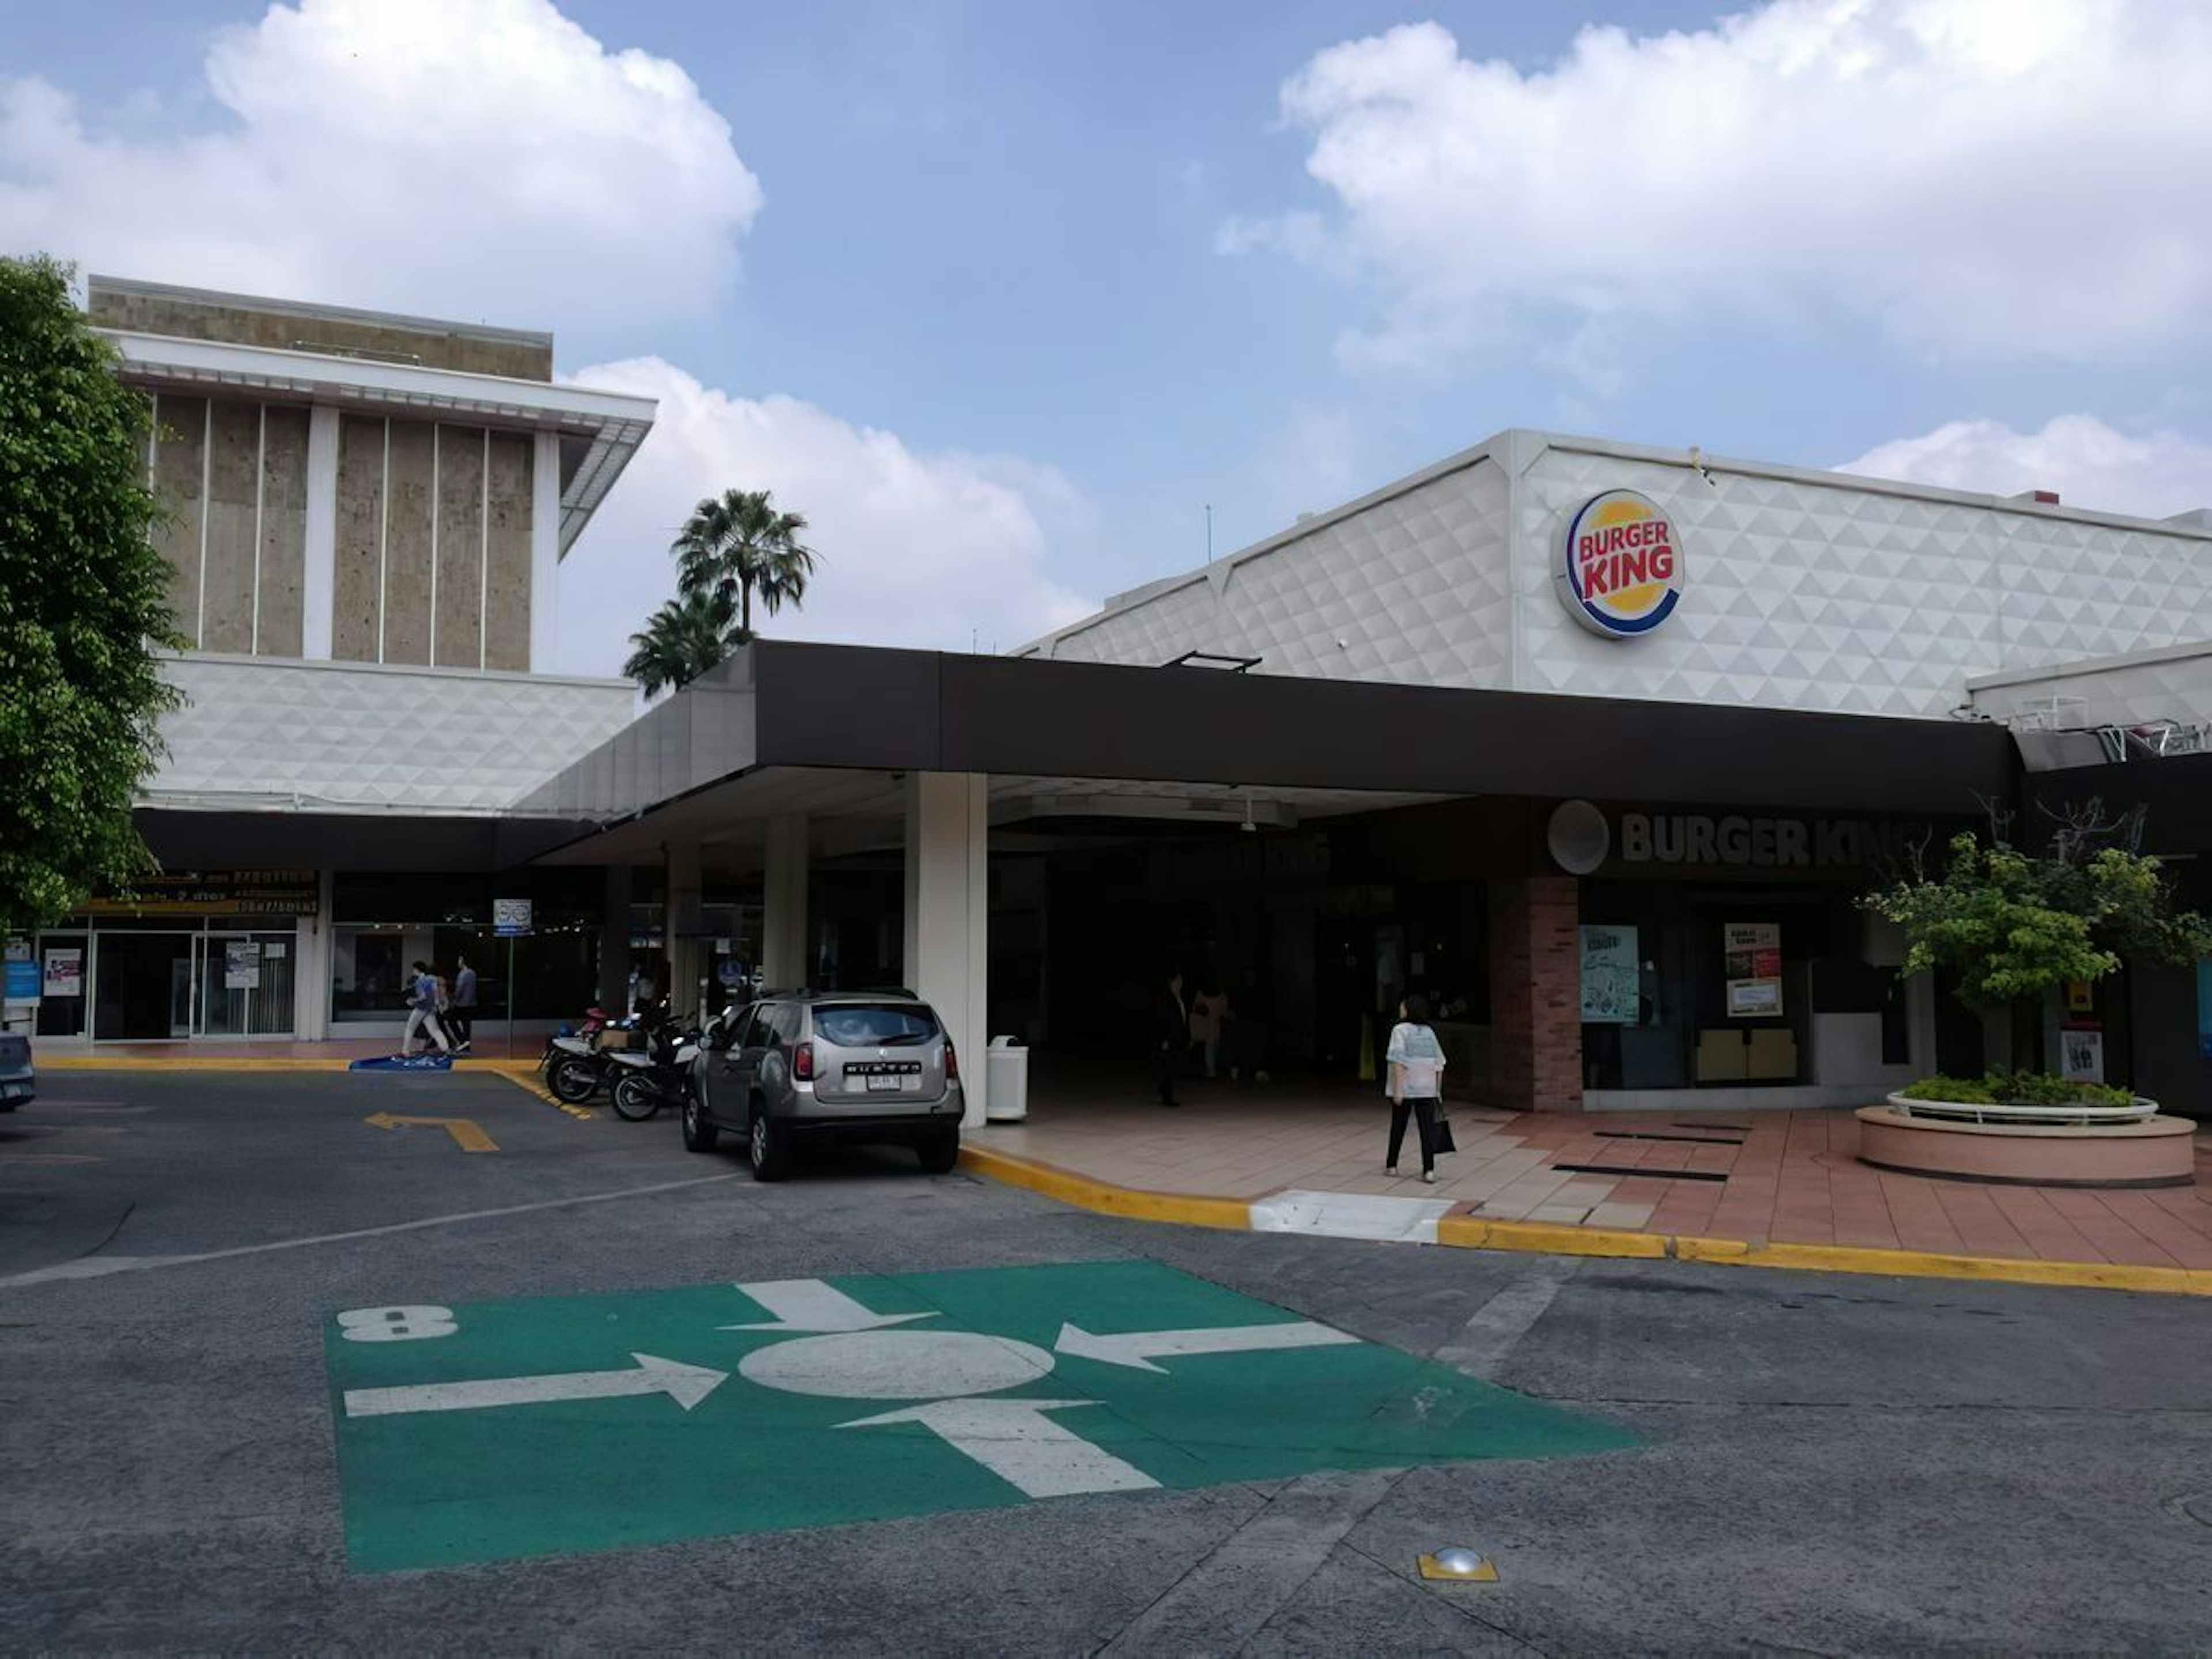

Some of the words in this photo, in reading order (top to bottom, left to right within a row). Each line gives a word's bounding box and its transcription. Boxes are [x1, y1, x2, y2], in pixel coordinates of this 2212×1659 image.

[1579, 521, 1669, 563] BURGER
[1584, 546, 1673, 599] KING
[1621, 812, 1810, 866] BURGER
